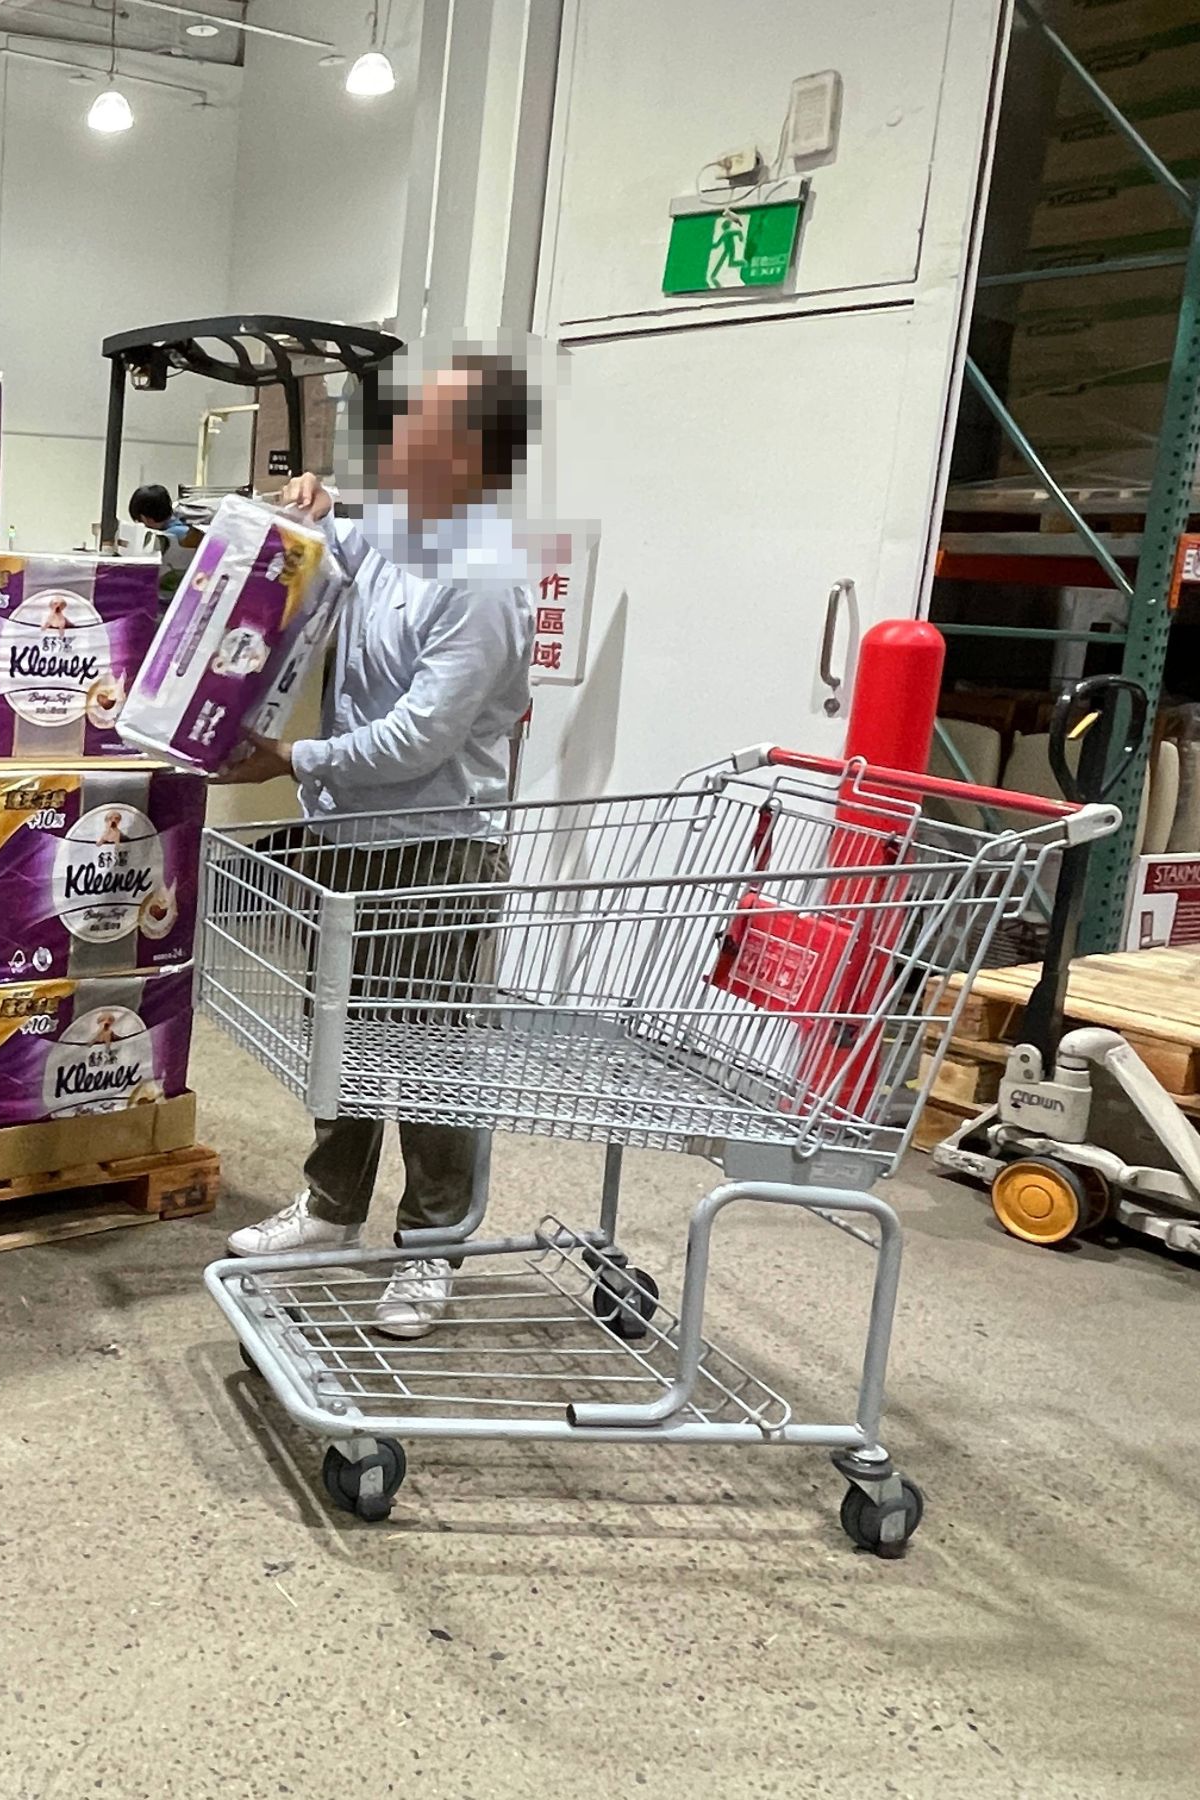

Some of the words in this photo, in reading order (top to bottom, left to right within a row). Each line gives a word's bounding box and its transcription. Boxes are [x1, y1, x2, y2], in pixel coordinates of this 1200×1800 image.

[10, 645, 98, 685] Kleenex
[64, 863, 152, 898] Kleenex
[55, 1062, 143, 1098] Kleenex
